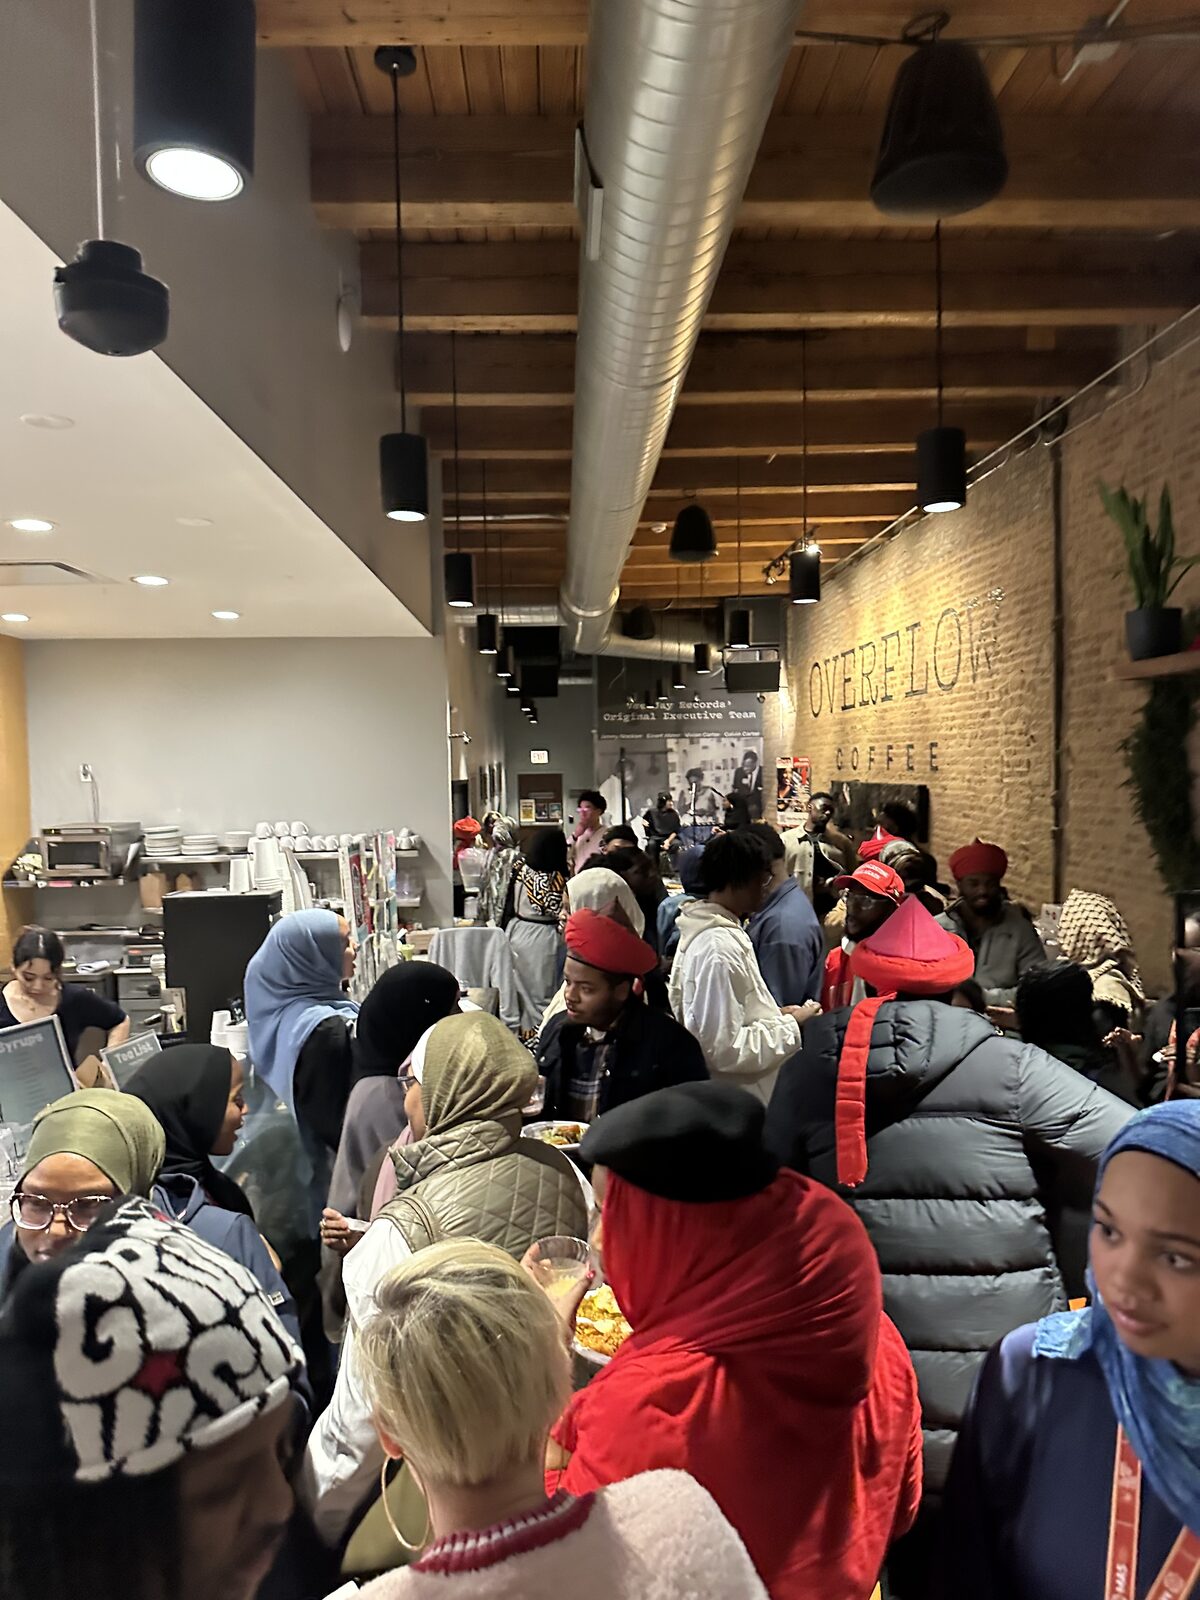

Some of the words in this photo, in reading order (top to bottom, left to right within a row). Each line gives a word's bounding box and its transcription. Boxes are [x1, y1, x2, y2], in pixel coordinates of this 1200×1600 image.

[809, 587, 1006, 719] OVERFLOW
[655, 701, 673, 711] Jay
[603, 713, 656, 723] Original
[663, 711, 723, 720] Executive
[728, 710, 757, 719] Team
[835, 741, 939, 772] COFFEE
[135, 1042, 154, 1058] List
